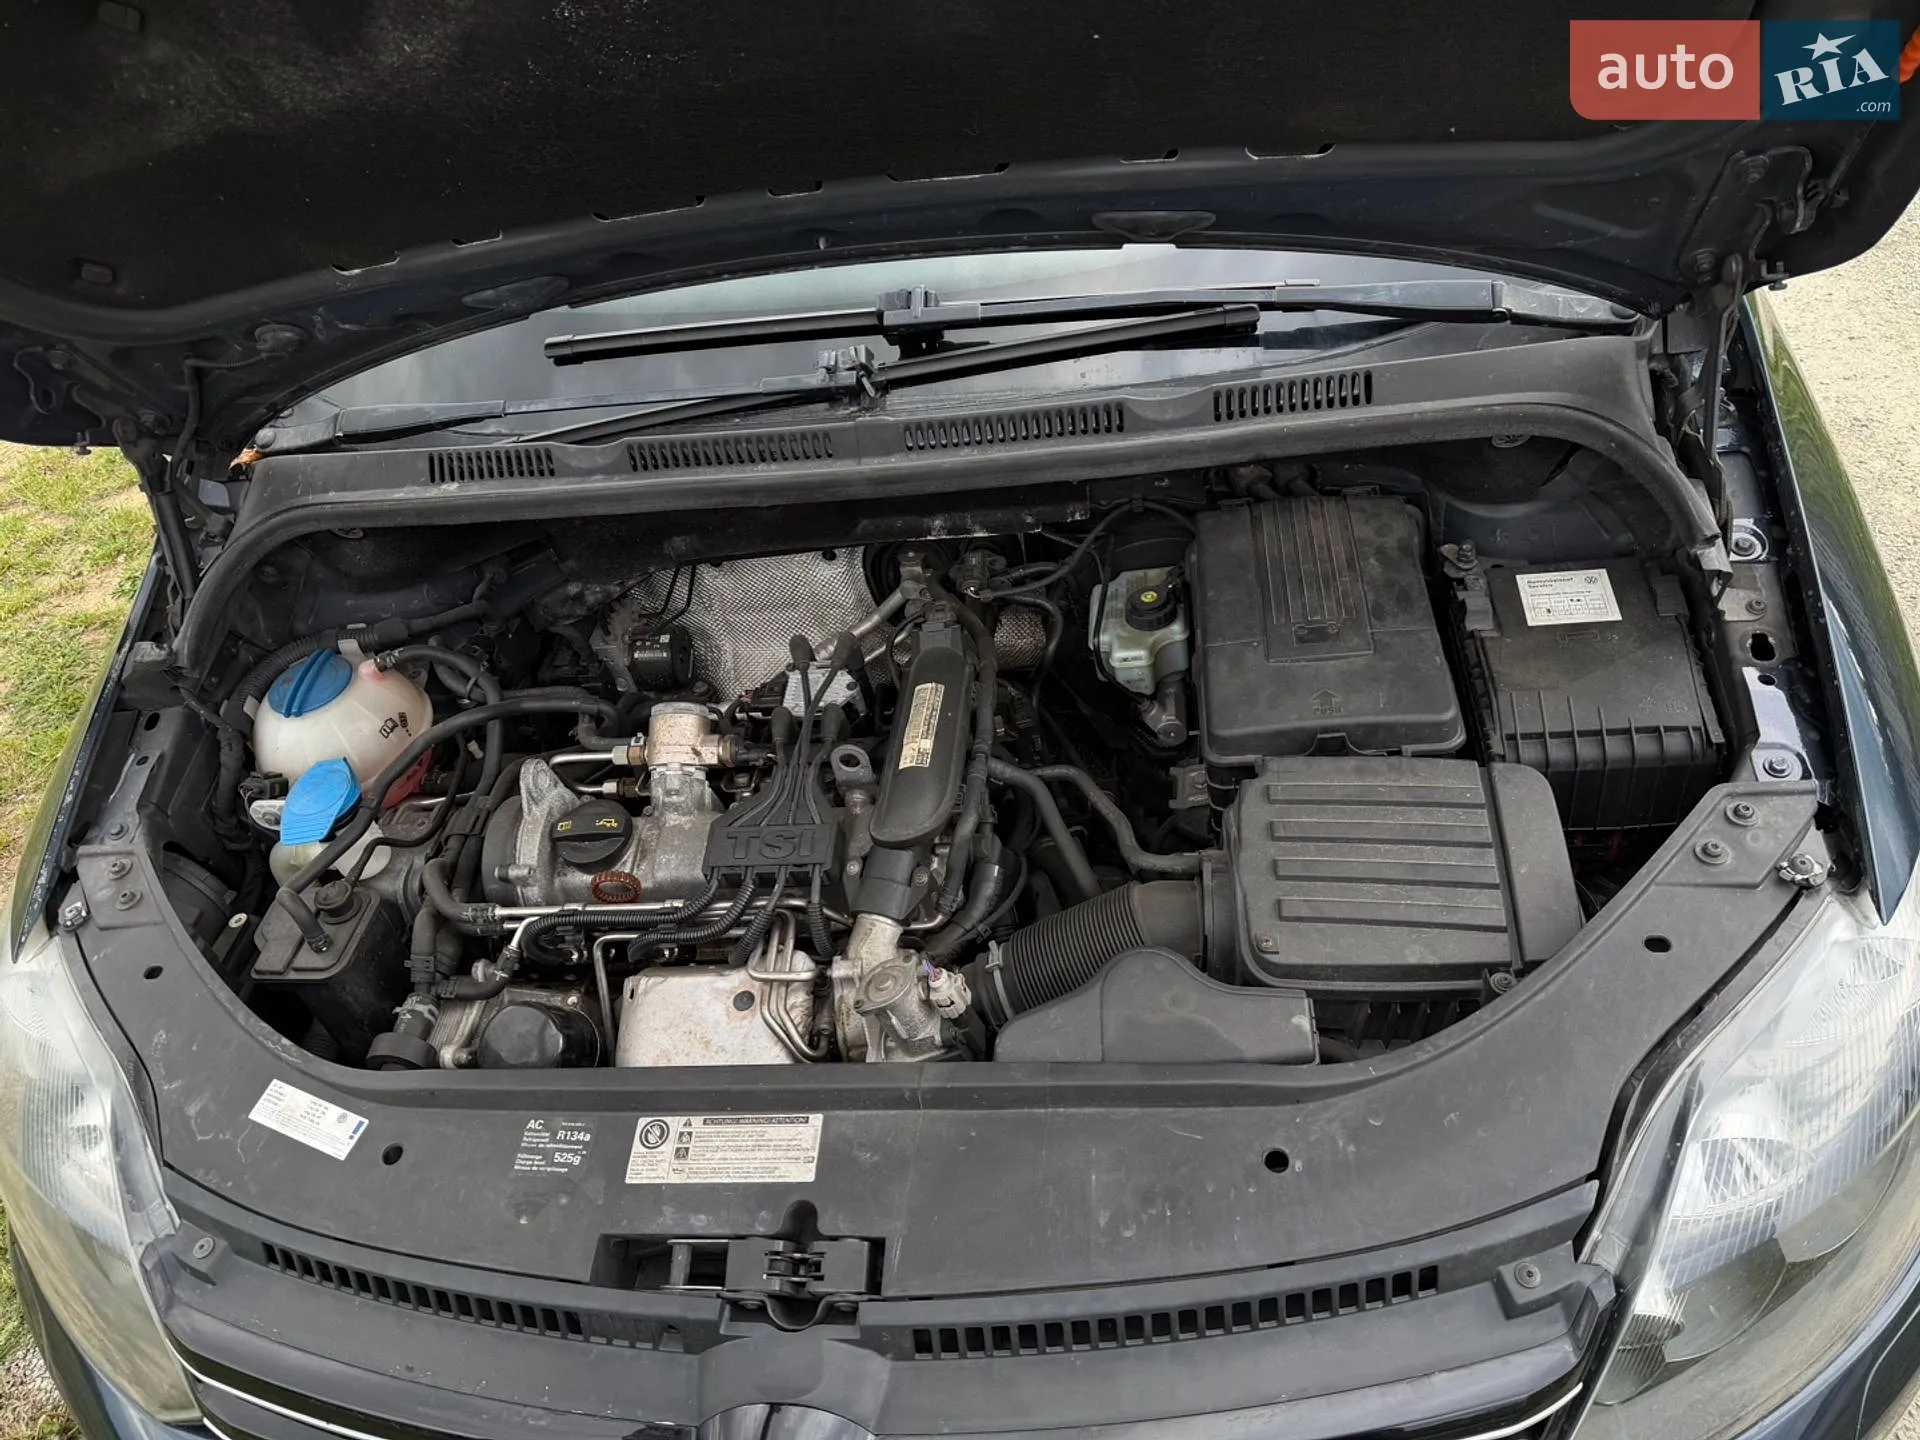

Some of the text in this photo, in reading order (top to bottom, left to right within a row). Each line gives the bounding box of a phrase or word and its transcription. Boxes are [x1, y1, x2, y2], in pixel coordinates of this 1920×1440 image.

[726, 828, 815, 860] TSI
[526, 1119, 545, 1130] AC
[556, 1130, 591, 1142] R134a
[553, 1151, 582, 1166] 525g
